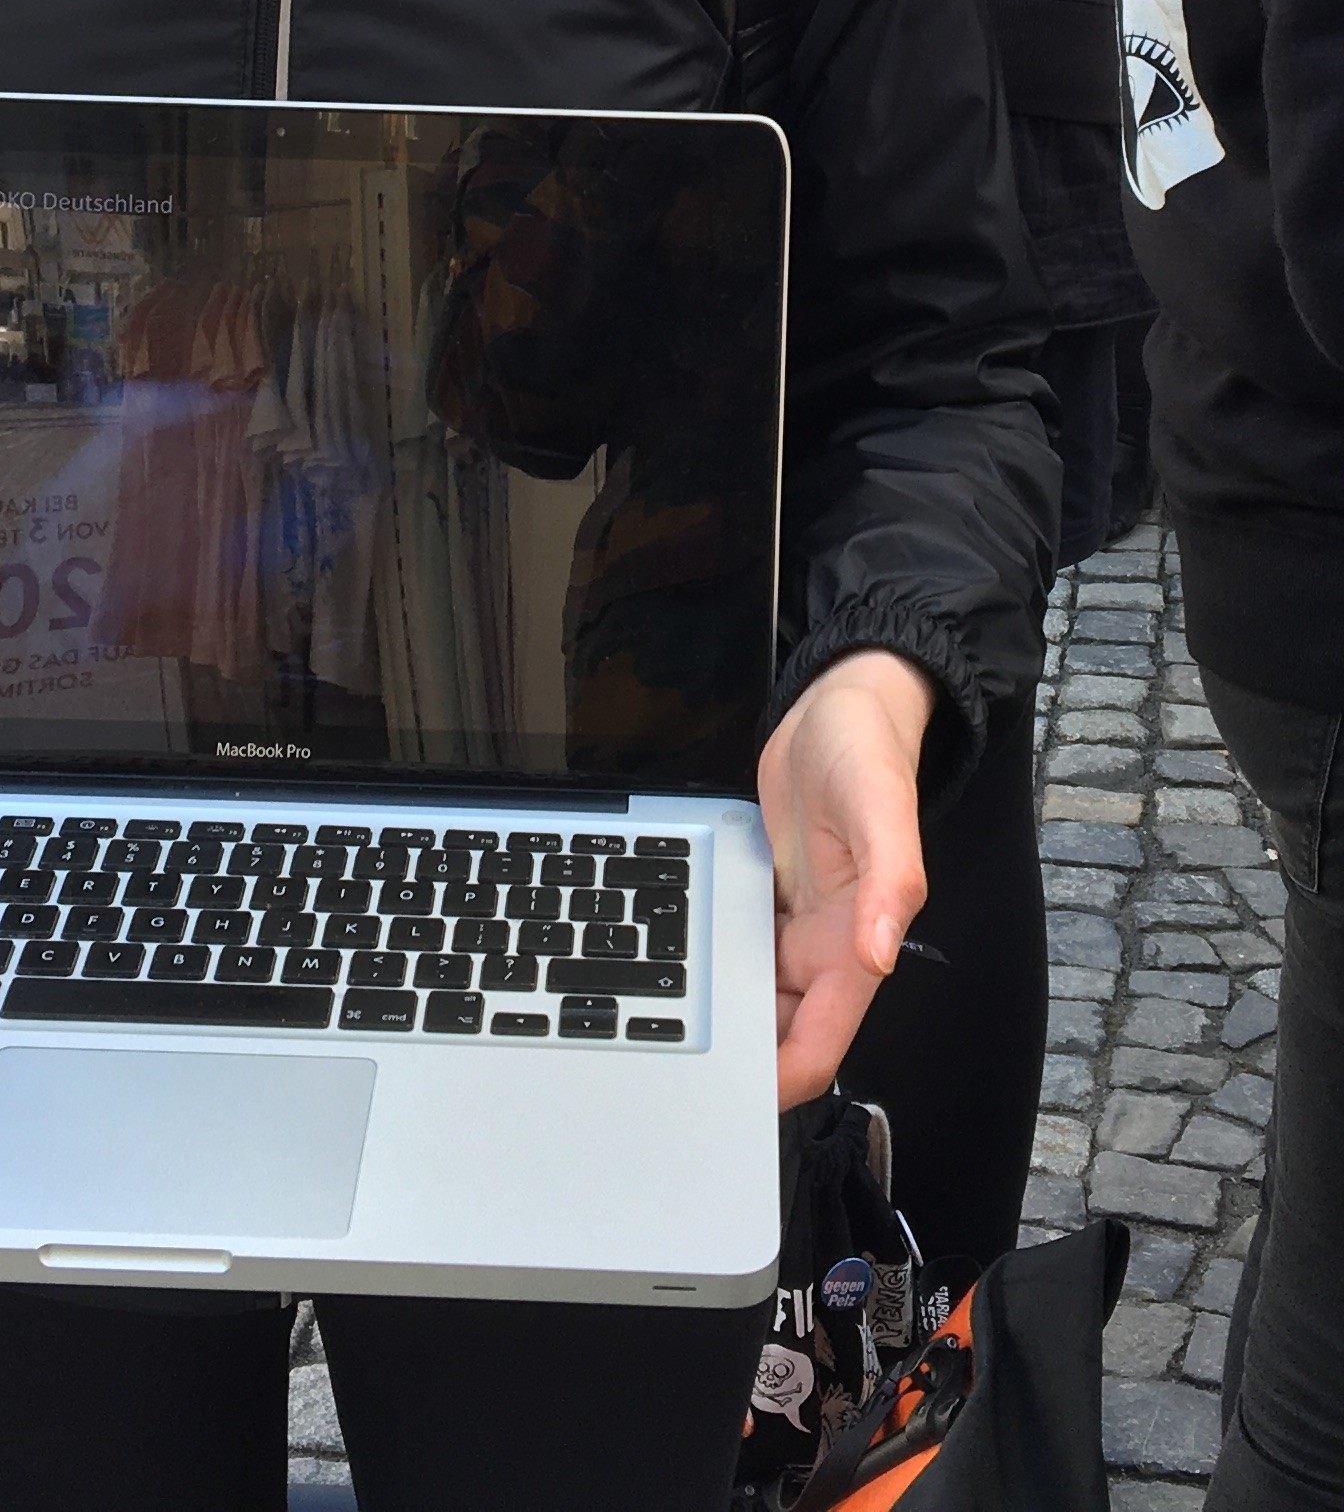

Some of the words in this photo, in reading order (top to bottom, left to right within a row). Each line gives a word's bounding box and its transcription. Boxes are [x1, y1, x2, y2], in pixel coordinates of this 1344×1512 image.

[43, 192, 173, 214] Deutschland
[216, 742, 284, 758] MacBook
[286, 744, 311, 759] Pro
[20, 878, 31, 888] E
[82, 880, 94, 891] R
[148, 881, 159, 892] T
[211, 884, 223, 895] Y
[273, 886, 286, 896] U
[399, 890, 413, 900] O
[464, 892, 476, 902] P
[21, 913, 34, 924] D
[87, 915, 99, 926] F
[150, 917, 164, 927] G
[214, 919, 230, 930] H
[345, 923, 357, 934] K
[411, 926, 421, 937] L
[41, 950, 54, 961] C
[108, 952, 121, 963] V
[173, 954, 185, 966] B
[238, 956, 252, 967] N
[302, 958, 319, 969] M
[382, 1012, 406, 1021] cmd
[823, 1280, 865, 1294] gegen
[827, 1294, 856, 1307] Pelz
